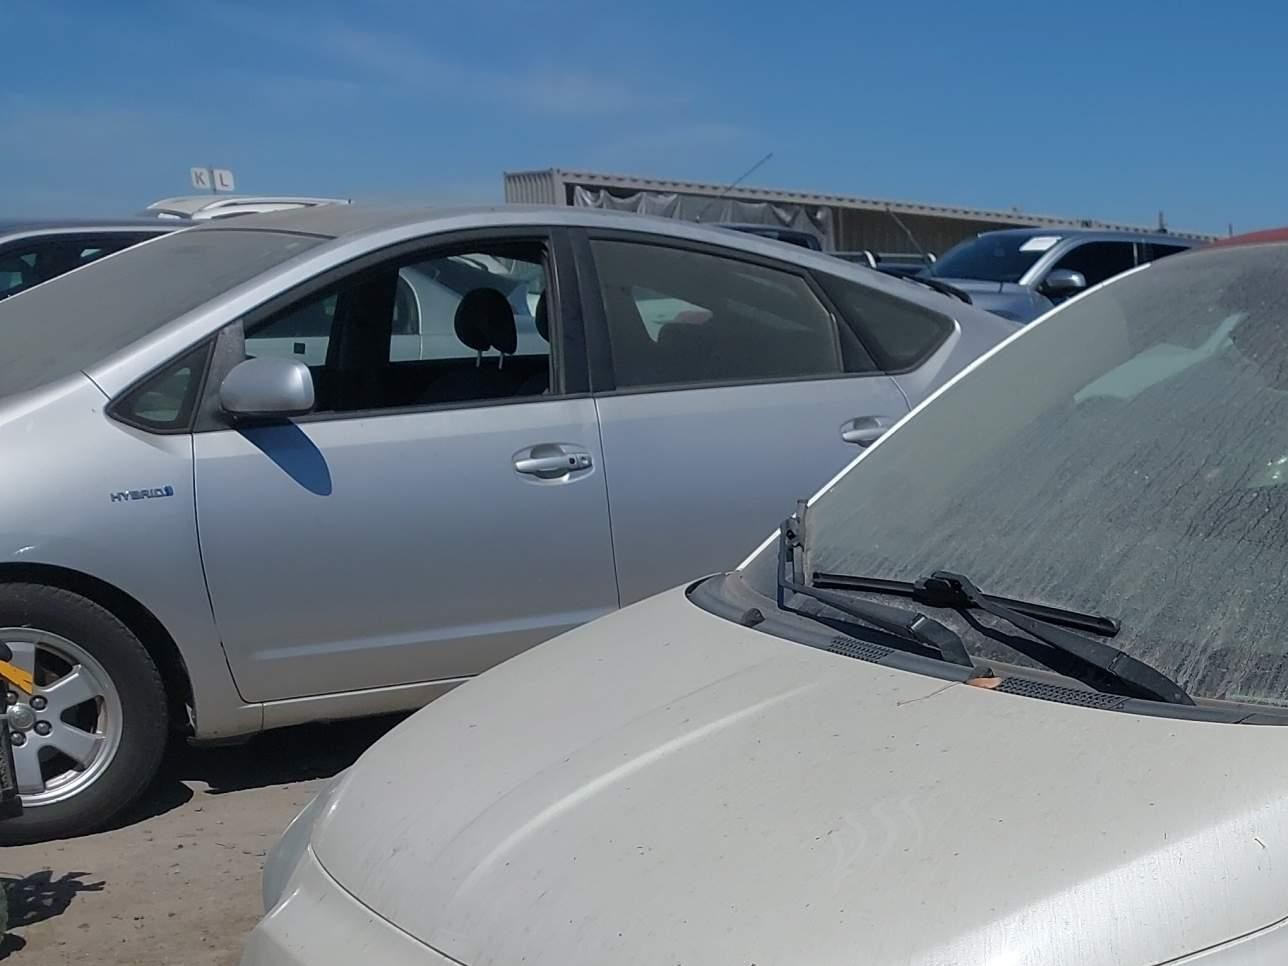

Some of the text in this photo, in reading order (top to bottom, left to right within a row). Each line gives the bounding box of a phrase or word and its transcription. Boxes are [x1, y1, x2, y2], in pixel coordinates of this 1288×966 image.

[194, 171, 206, 185] K
[219, 172, 229, 187] L
[110, 488, 163, 502] HYBRID
